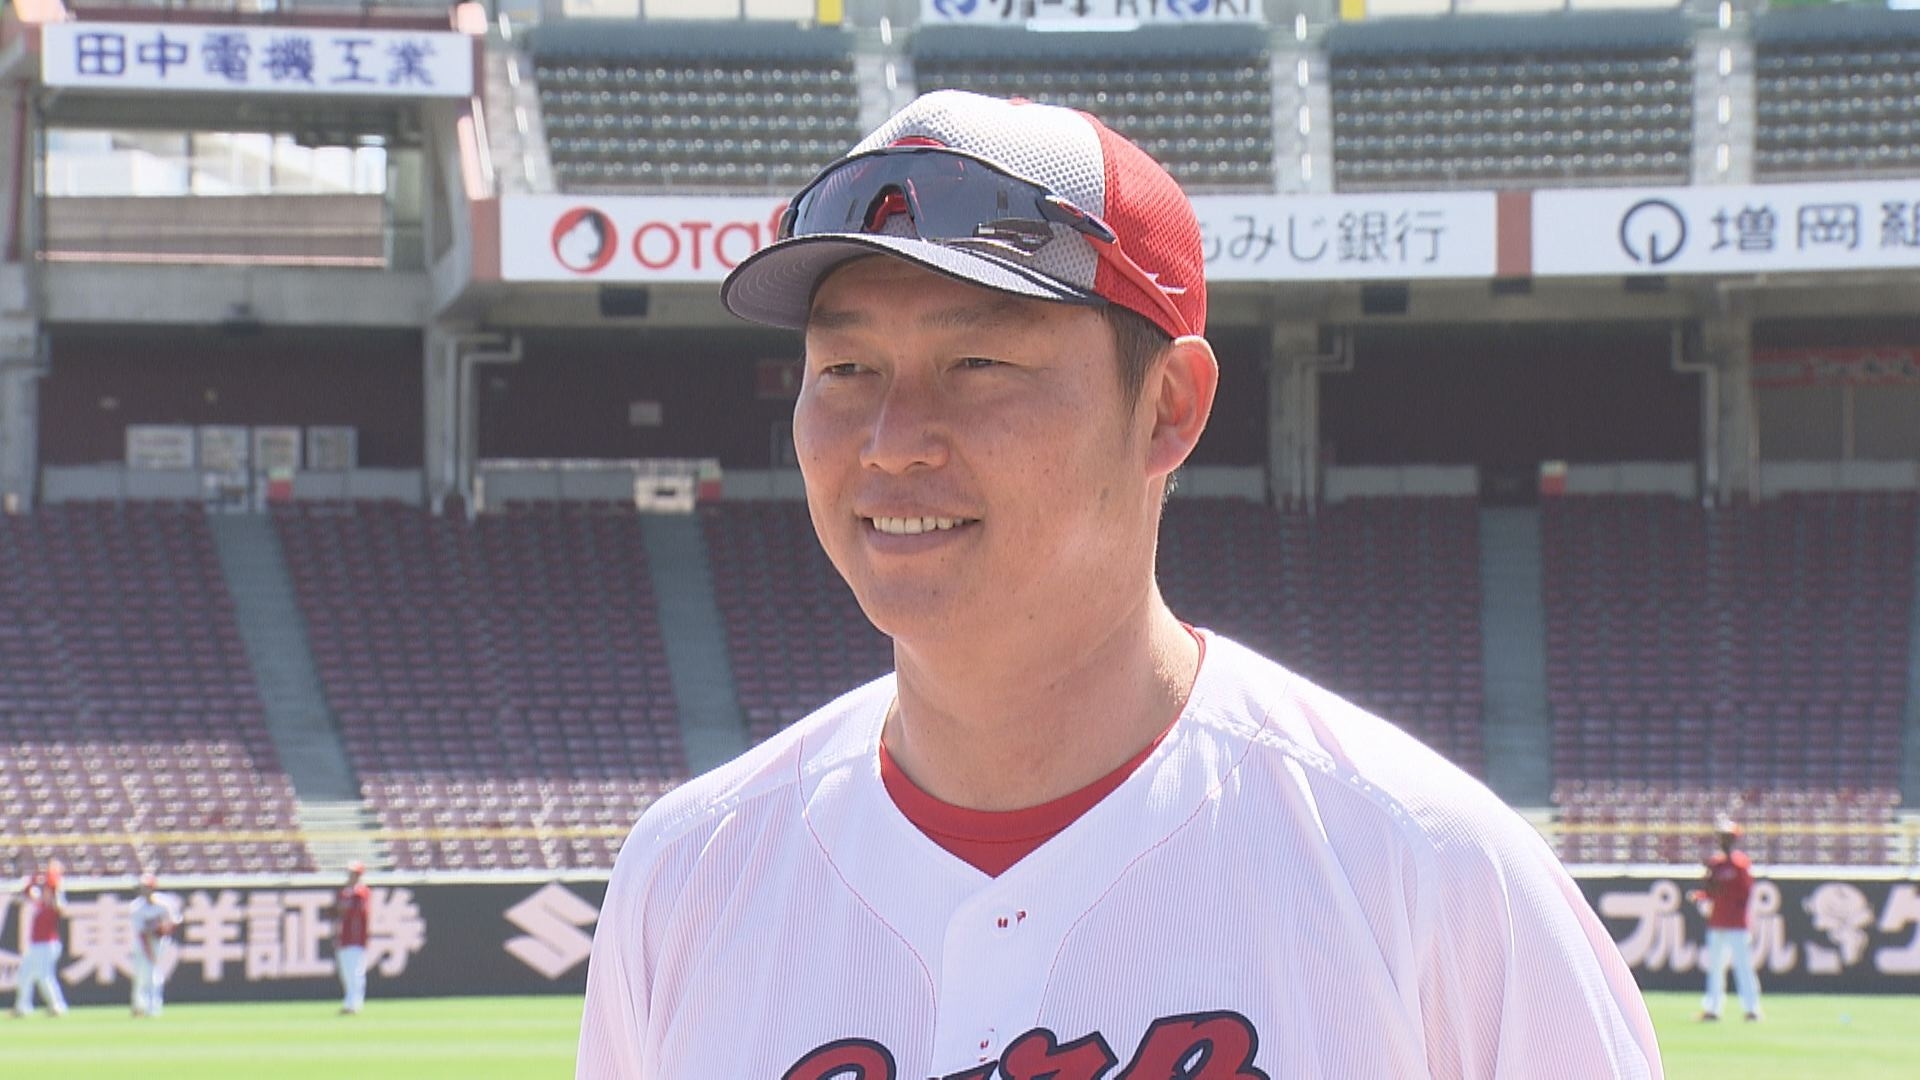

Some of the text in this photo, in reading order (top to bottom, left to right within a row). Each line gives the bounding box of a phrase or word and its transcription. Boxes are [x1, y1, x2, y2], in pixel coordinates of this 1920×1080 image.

[76, 31, 438, 87] 田中電機工業
